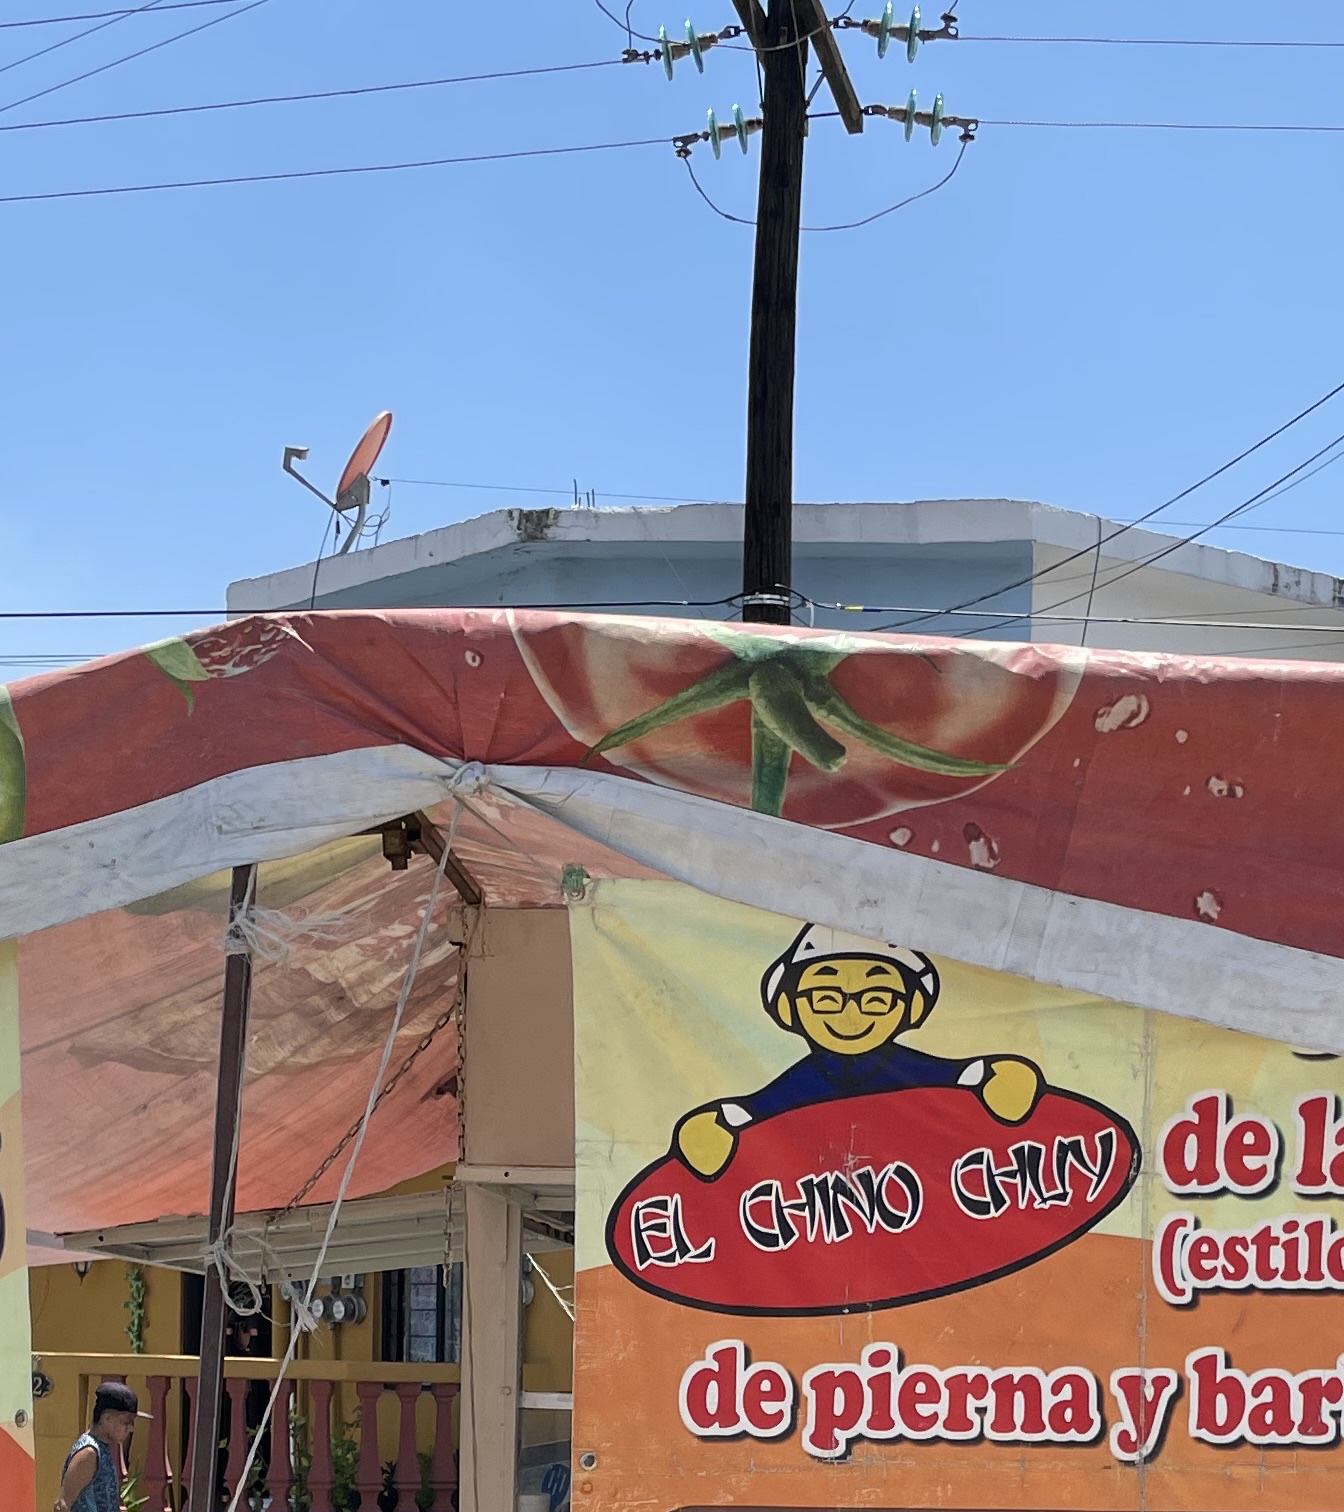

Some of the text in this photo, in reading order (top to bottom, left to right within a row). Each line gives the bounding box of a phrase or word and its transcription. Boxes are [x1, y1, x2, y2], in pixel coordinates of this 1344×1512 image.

[1160, 1093, 1274, 1190] de
[631, 1127, 1118, 1271] EL CHINO CHUY
[683, 1344, 789, 1432] de
[805, 1346, 1097, 1453] pierna
[1114, 1372, 1174, 1456] y
